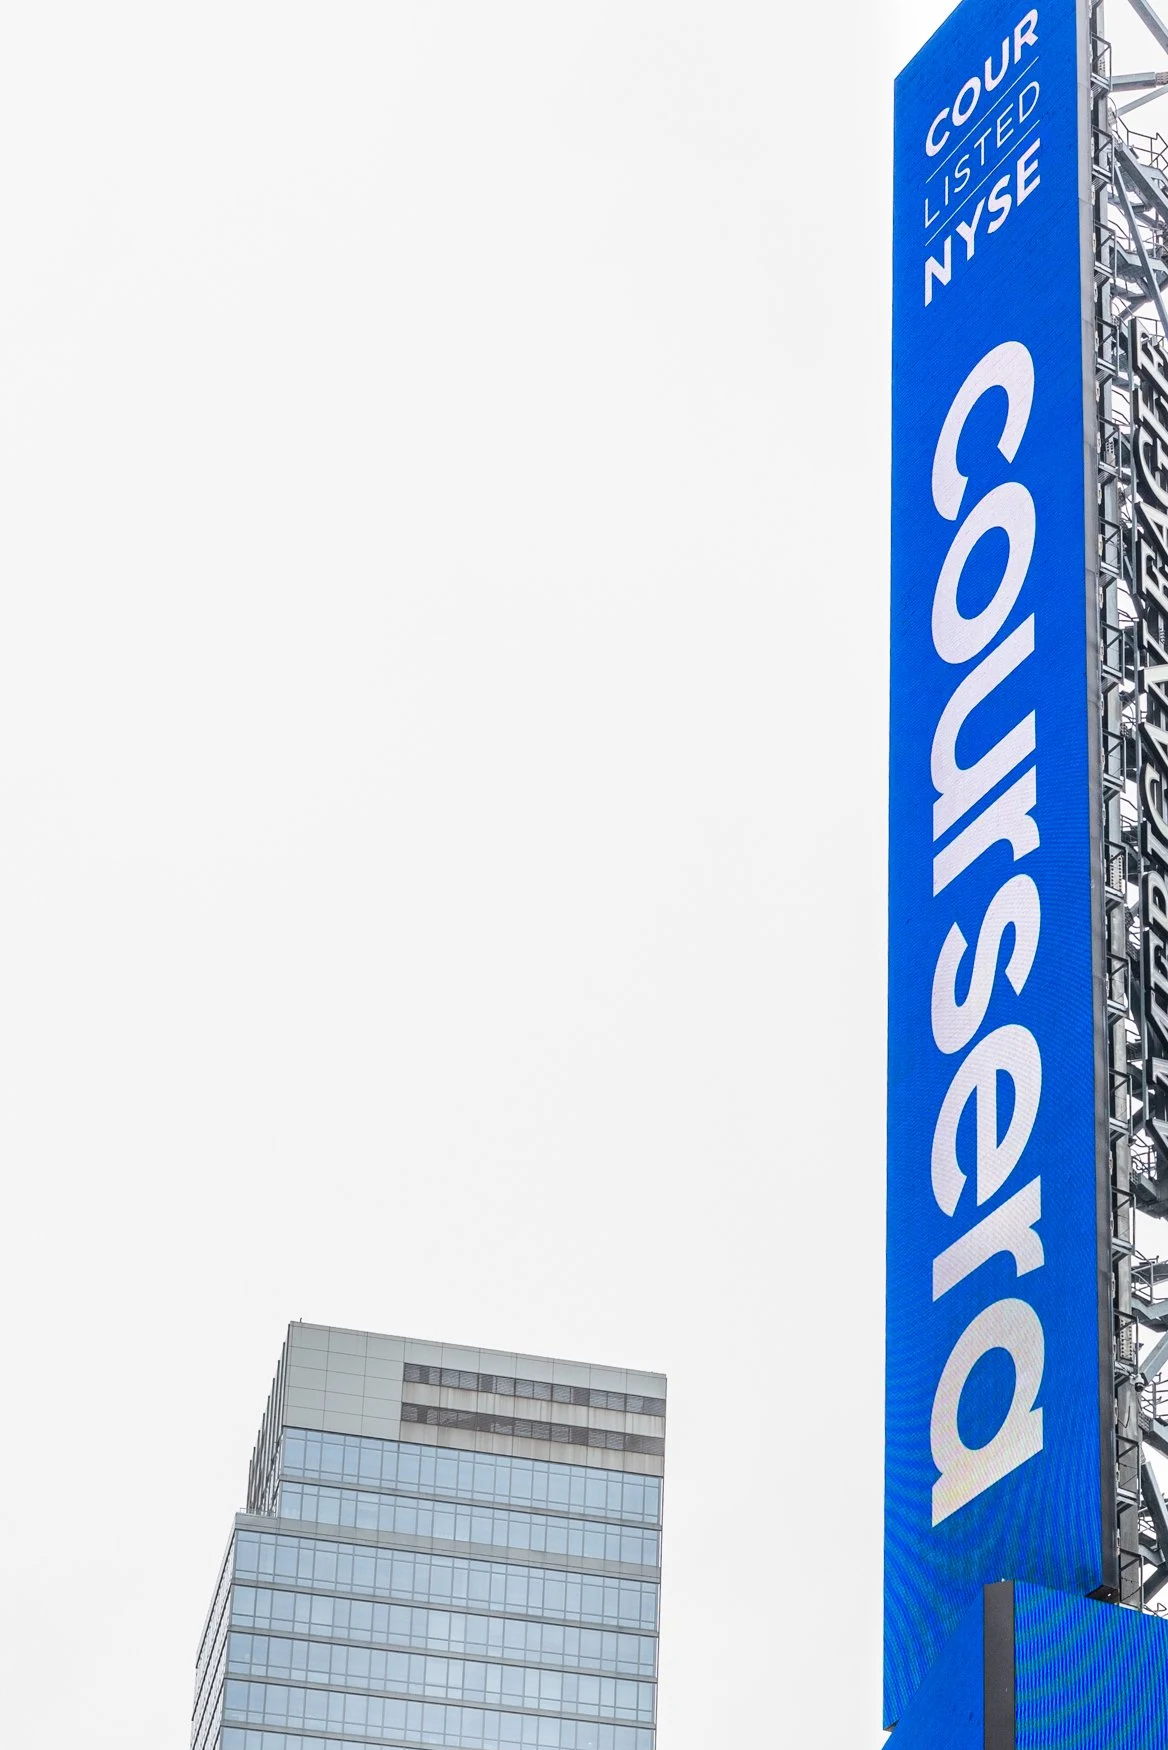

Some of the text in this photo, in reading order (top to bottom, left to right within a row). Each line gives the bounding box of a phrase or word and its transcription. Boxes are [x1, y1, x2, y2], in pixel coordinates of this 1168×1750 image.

[924, 80, 1041, 229] LISTED
[925, 8, 1040, 157] COUR
[924, 138, 1041, 306] NYSE
[930, 340, 1045, 1528] coursera
